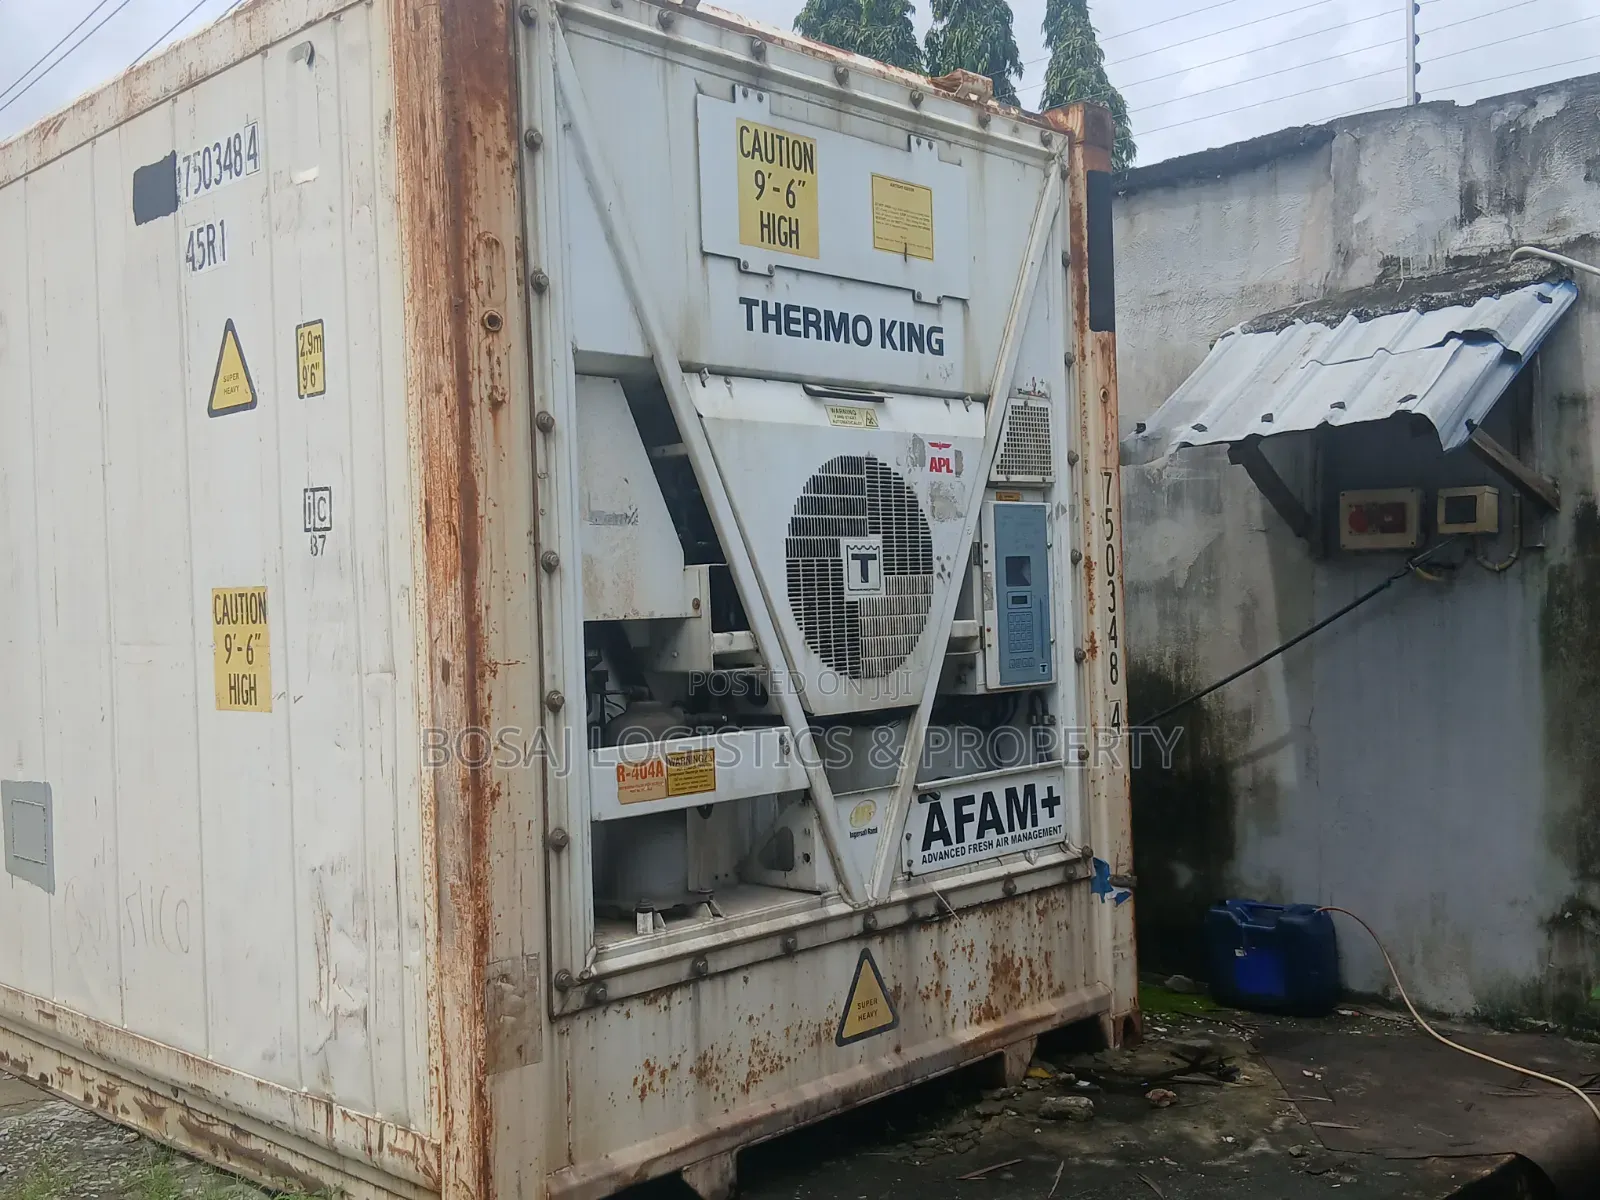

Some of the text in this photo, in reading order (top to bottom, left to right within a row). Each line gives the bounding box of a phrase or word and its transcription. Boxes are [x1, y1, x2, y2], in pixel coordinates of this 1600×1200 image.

[739, 125, 814, 175] CAUTION
[186, 219, 226, 272] 45R1
[759, 210, 800, 250] HIGH
[739, 296, 944, 357] THERMO KING
[223, 372, 239, 383] SUPER
[223, 385, 240, 395] HEAVY
[929, 456, 953, 474] APL
[851, 553, 877, 583] T
[214, 591, 267, 625] CAUTION
[228, 673, 257, 706] HIGH
[616, 759, 664, 782] R-404A
[921, 783, 1061, 852] AFAM+
[921, 824, 1063, 865] ADVANCED FRESH AIR MANAGEMENT
[857, 998, 878, 1010] SUPER
[858, 1010, 878, 1022] HEAVY
